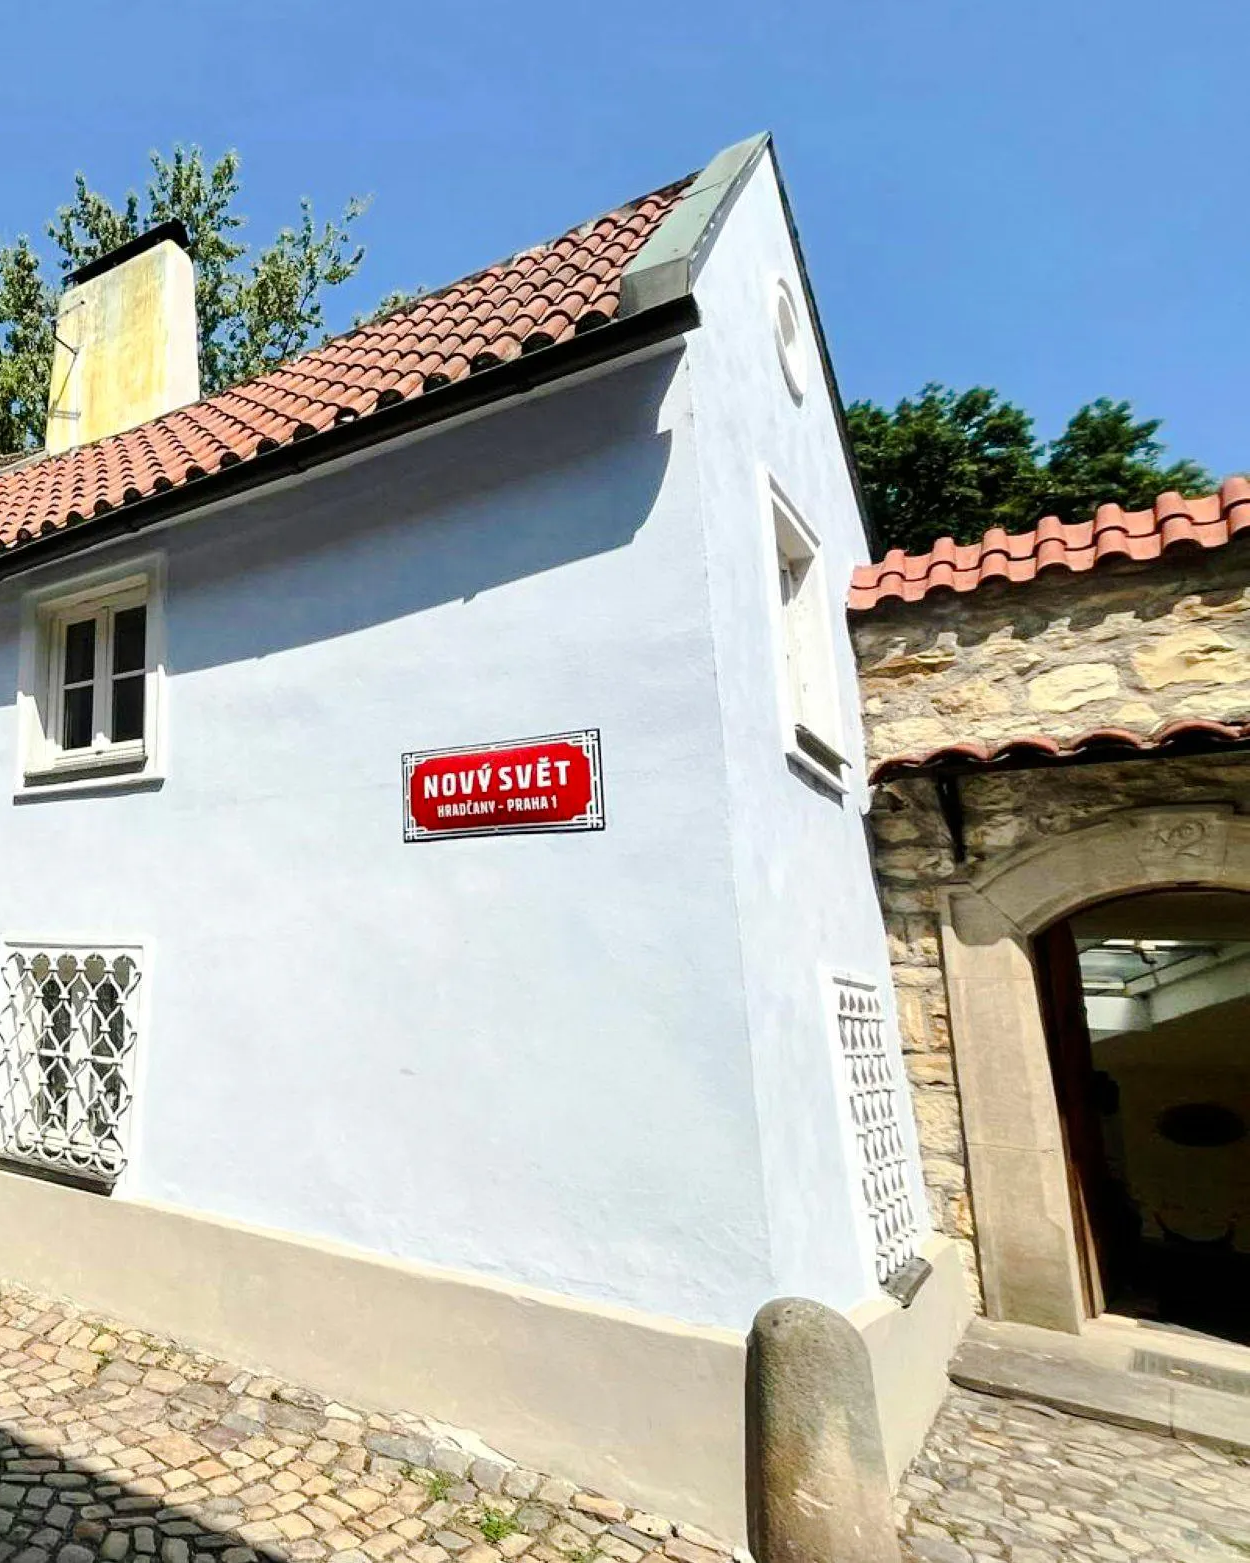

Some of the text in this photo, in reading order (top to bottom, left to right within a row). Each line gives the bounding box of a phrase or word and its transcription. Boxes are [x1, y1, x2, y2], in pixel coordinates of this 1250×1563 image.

[423, 756, 571, 799] NOVÝ SVĚT
[436, 799, 496, 818] HRADČANY
[506, 795, 549, 812] PRAHA
[551, 794, 558, 809] 1
